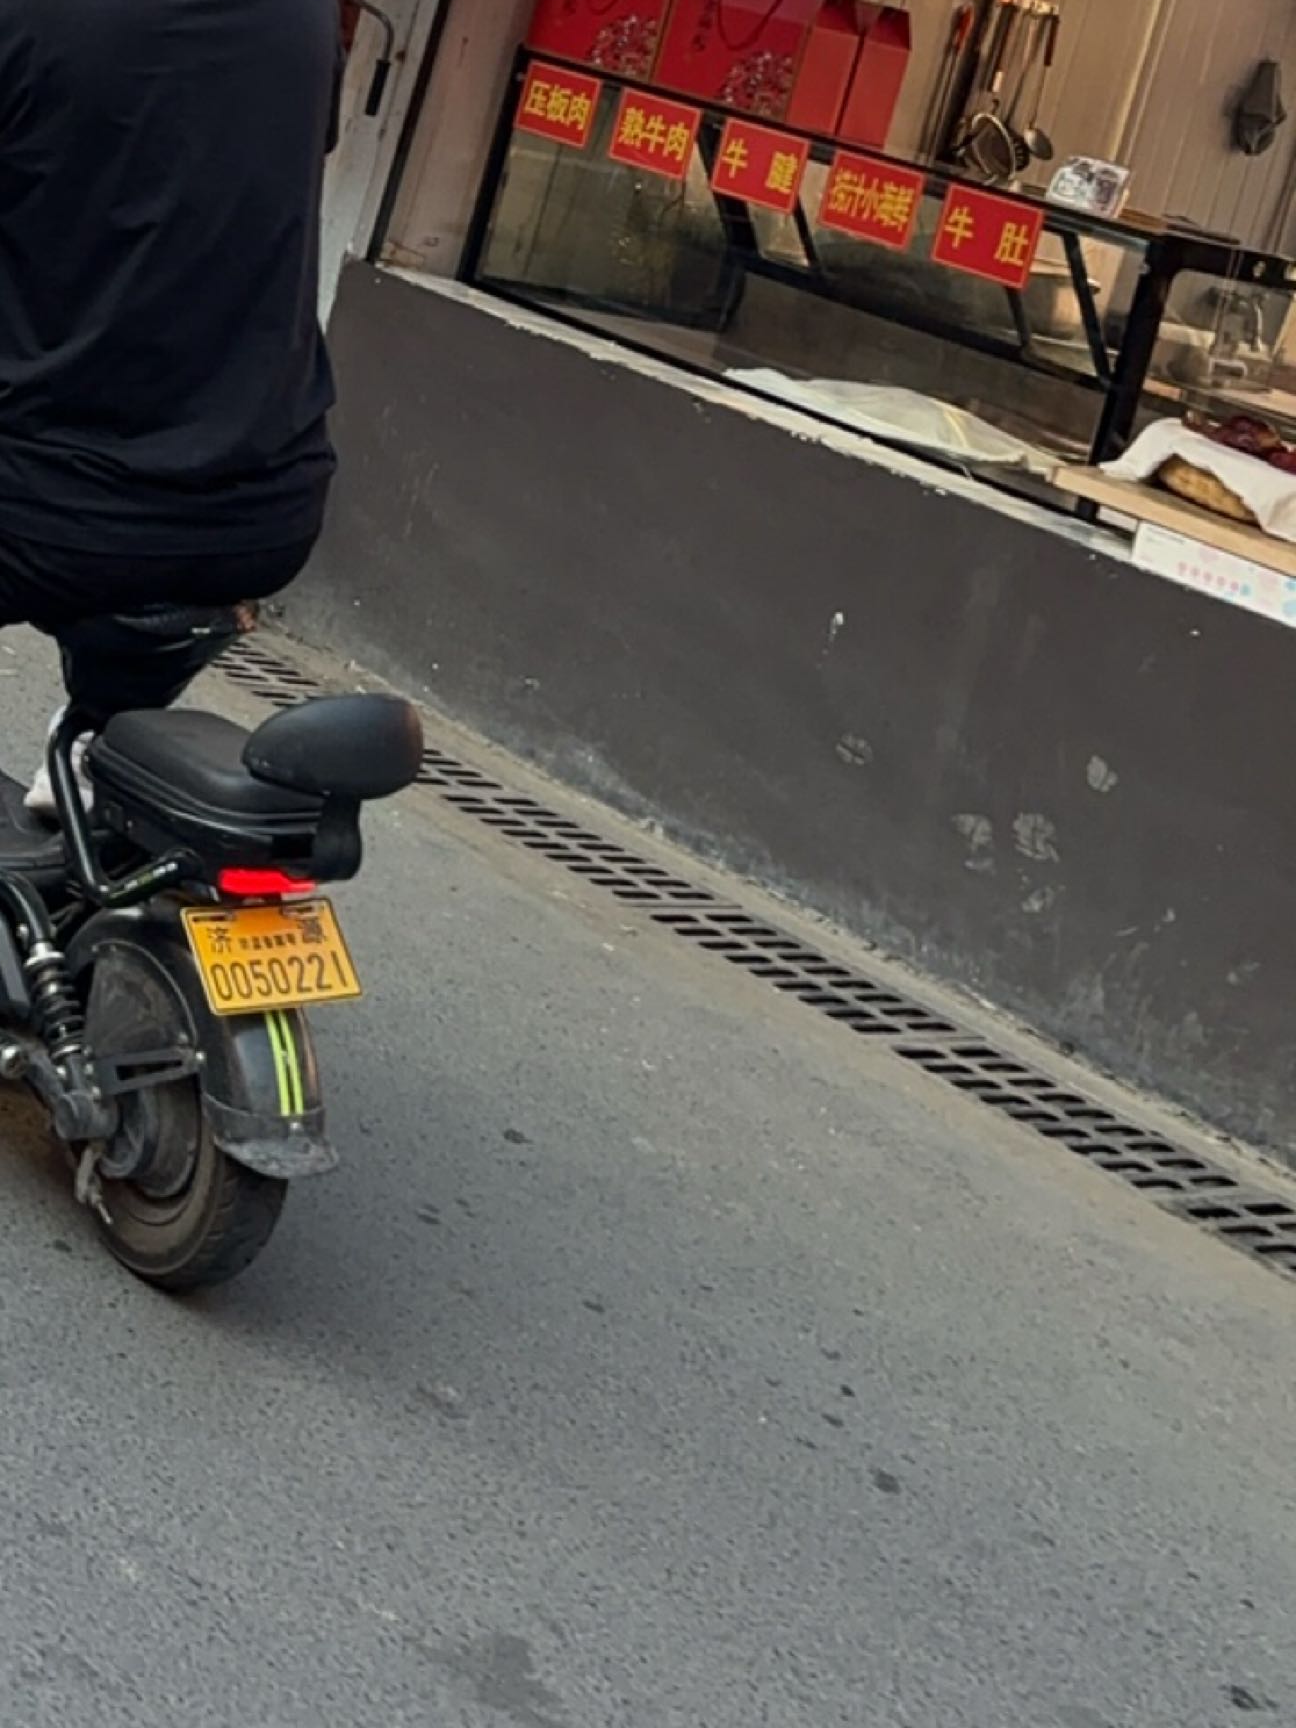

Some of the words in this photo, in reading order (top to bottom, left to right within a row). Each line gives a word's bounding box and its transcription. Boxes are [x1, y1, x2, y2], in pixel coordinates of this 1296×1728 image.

[524, 78, 592, 131] 压板肉
[944, 205, 1029, 267] 牛肚
[209, 949, 349, 1002] 0050221
